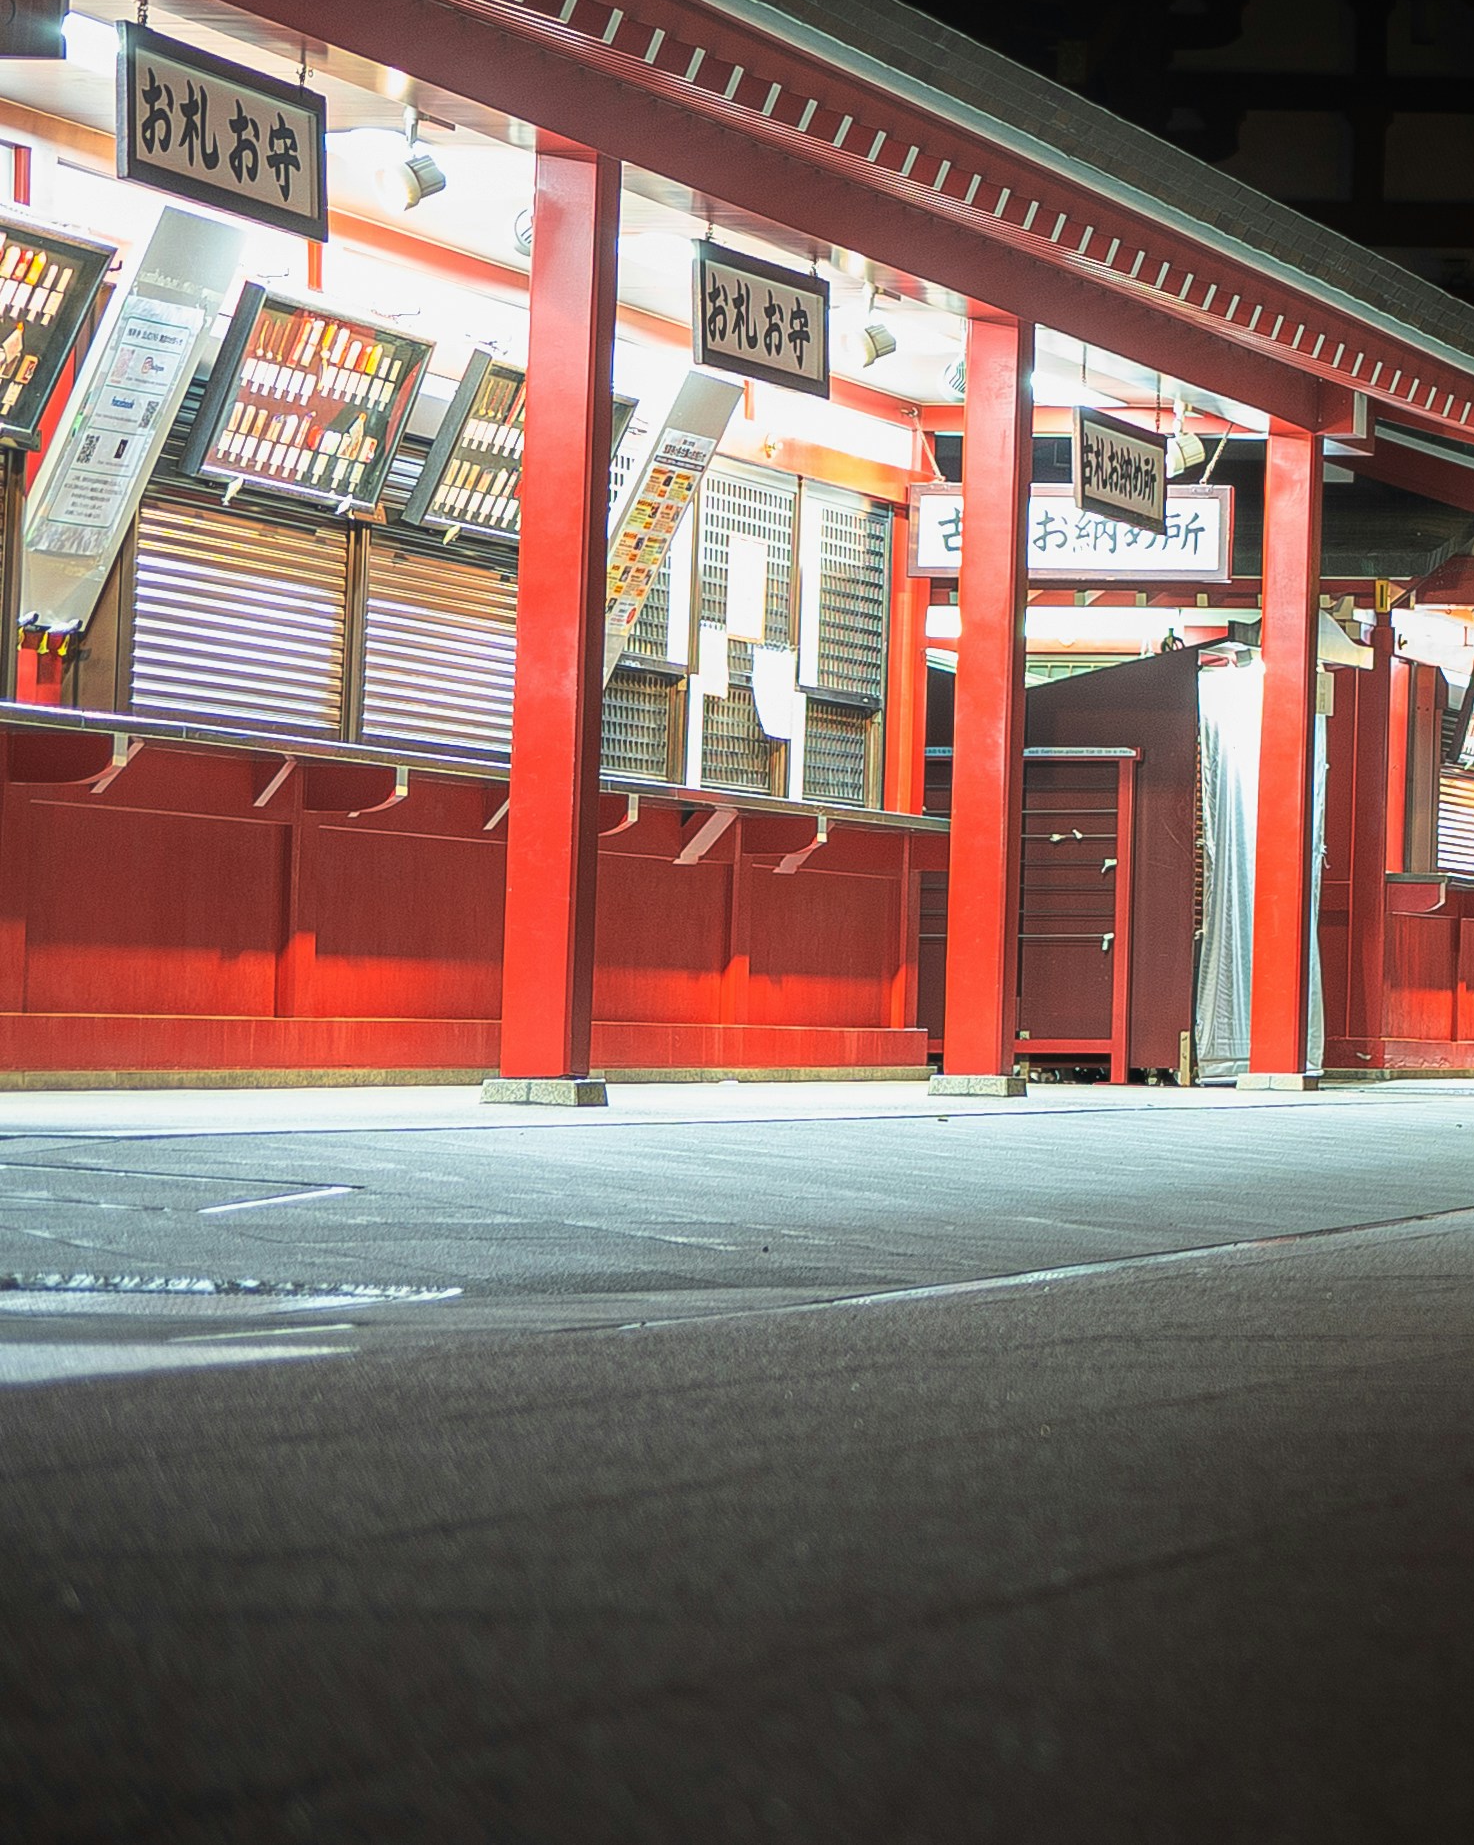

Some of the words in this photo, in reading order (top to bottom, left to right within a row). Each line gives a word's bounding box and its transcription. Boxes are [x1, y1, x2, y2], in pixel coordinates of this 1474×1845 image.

[141, 67, 301, 202] お札お守
[707, 272, 811, 370] お札お守
[1083, 432, 1157, 507] 古札お納め所
